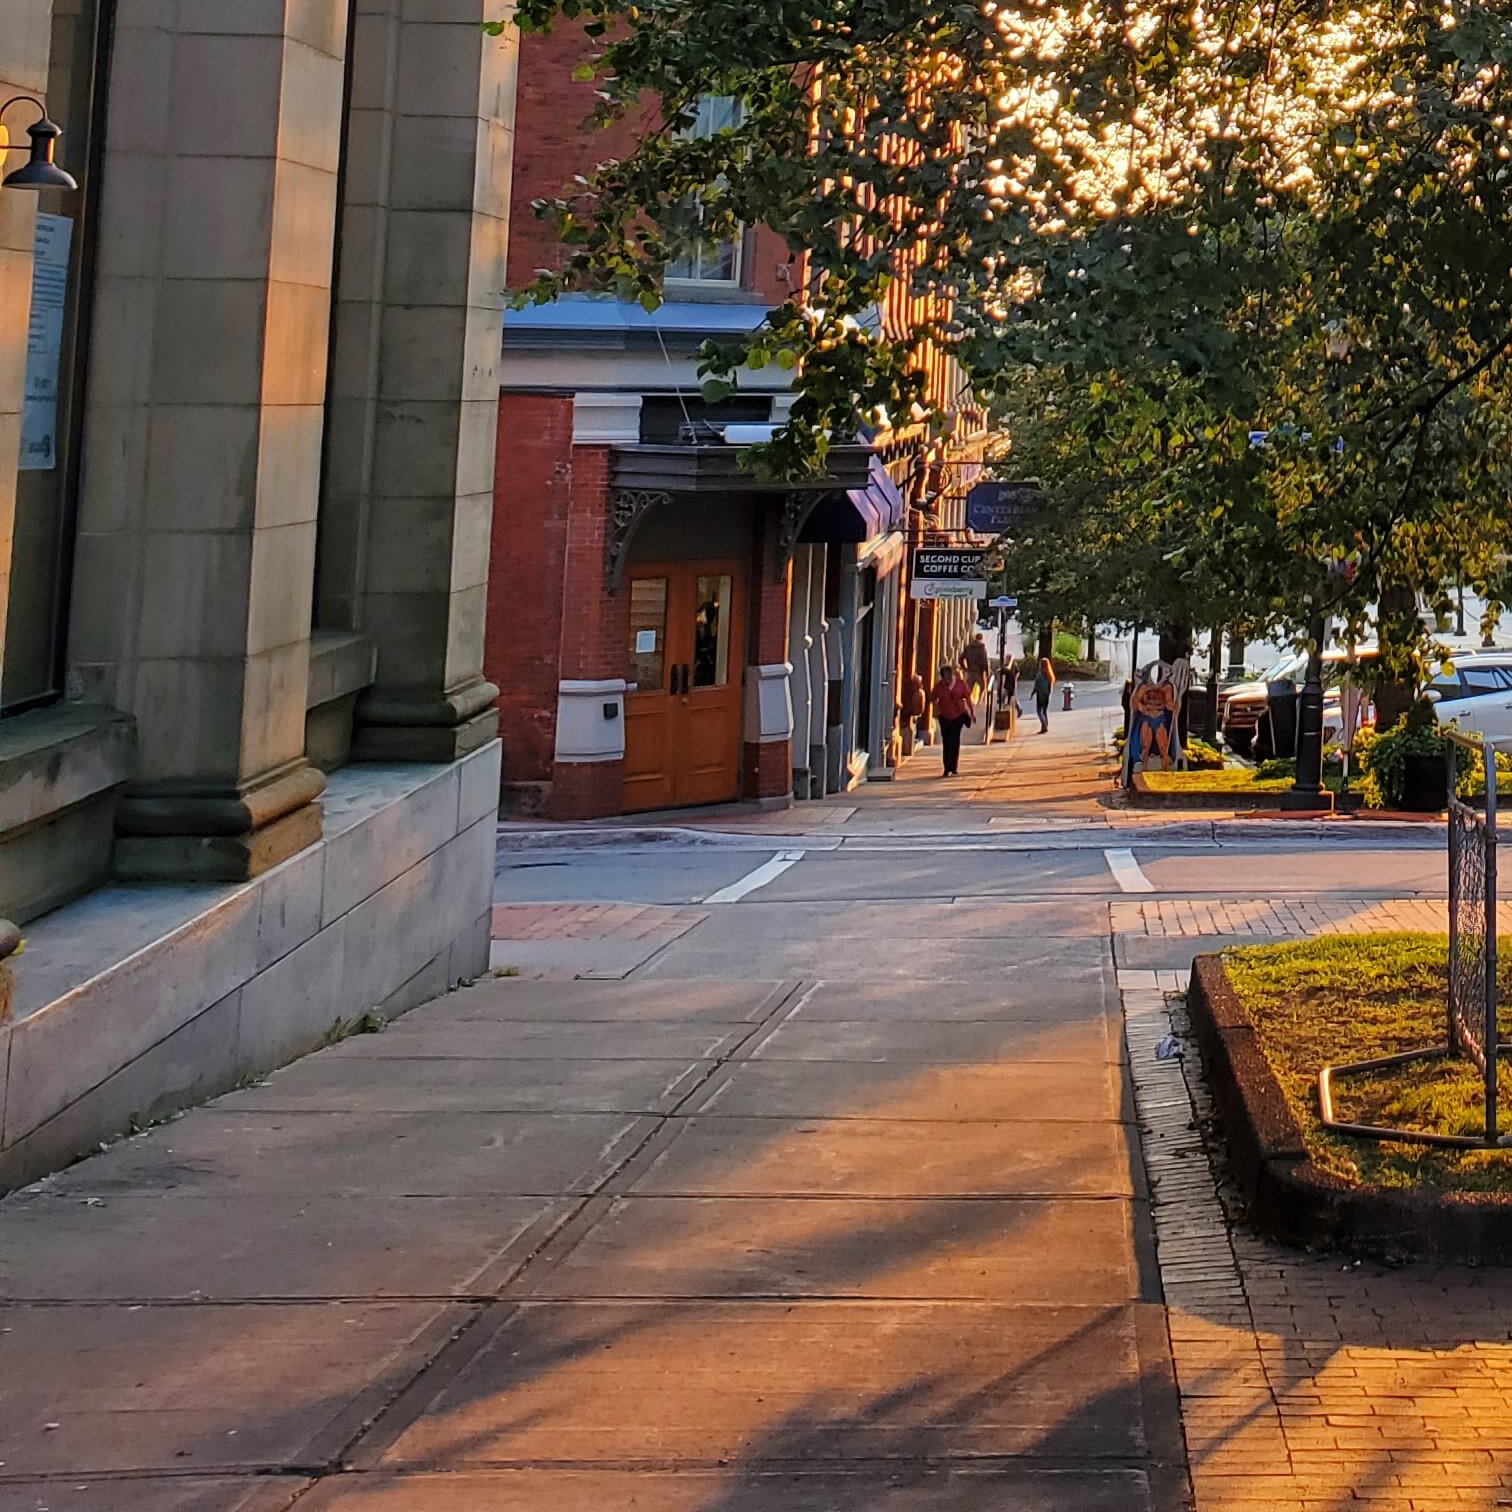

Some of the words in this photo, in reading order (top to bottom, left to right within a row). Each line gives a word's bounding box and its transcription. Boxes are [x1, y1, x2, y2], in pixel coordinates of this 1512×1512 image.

[919, 555, 959, 563] SECOND
[961, 555, 981, 563] CUP
[923, 565, 958, 573] COFFEE
